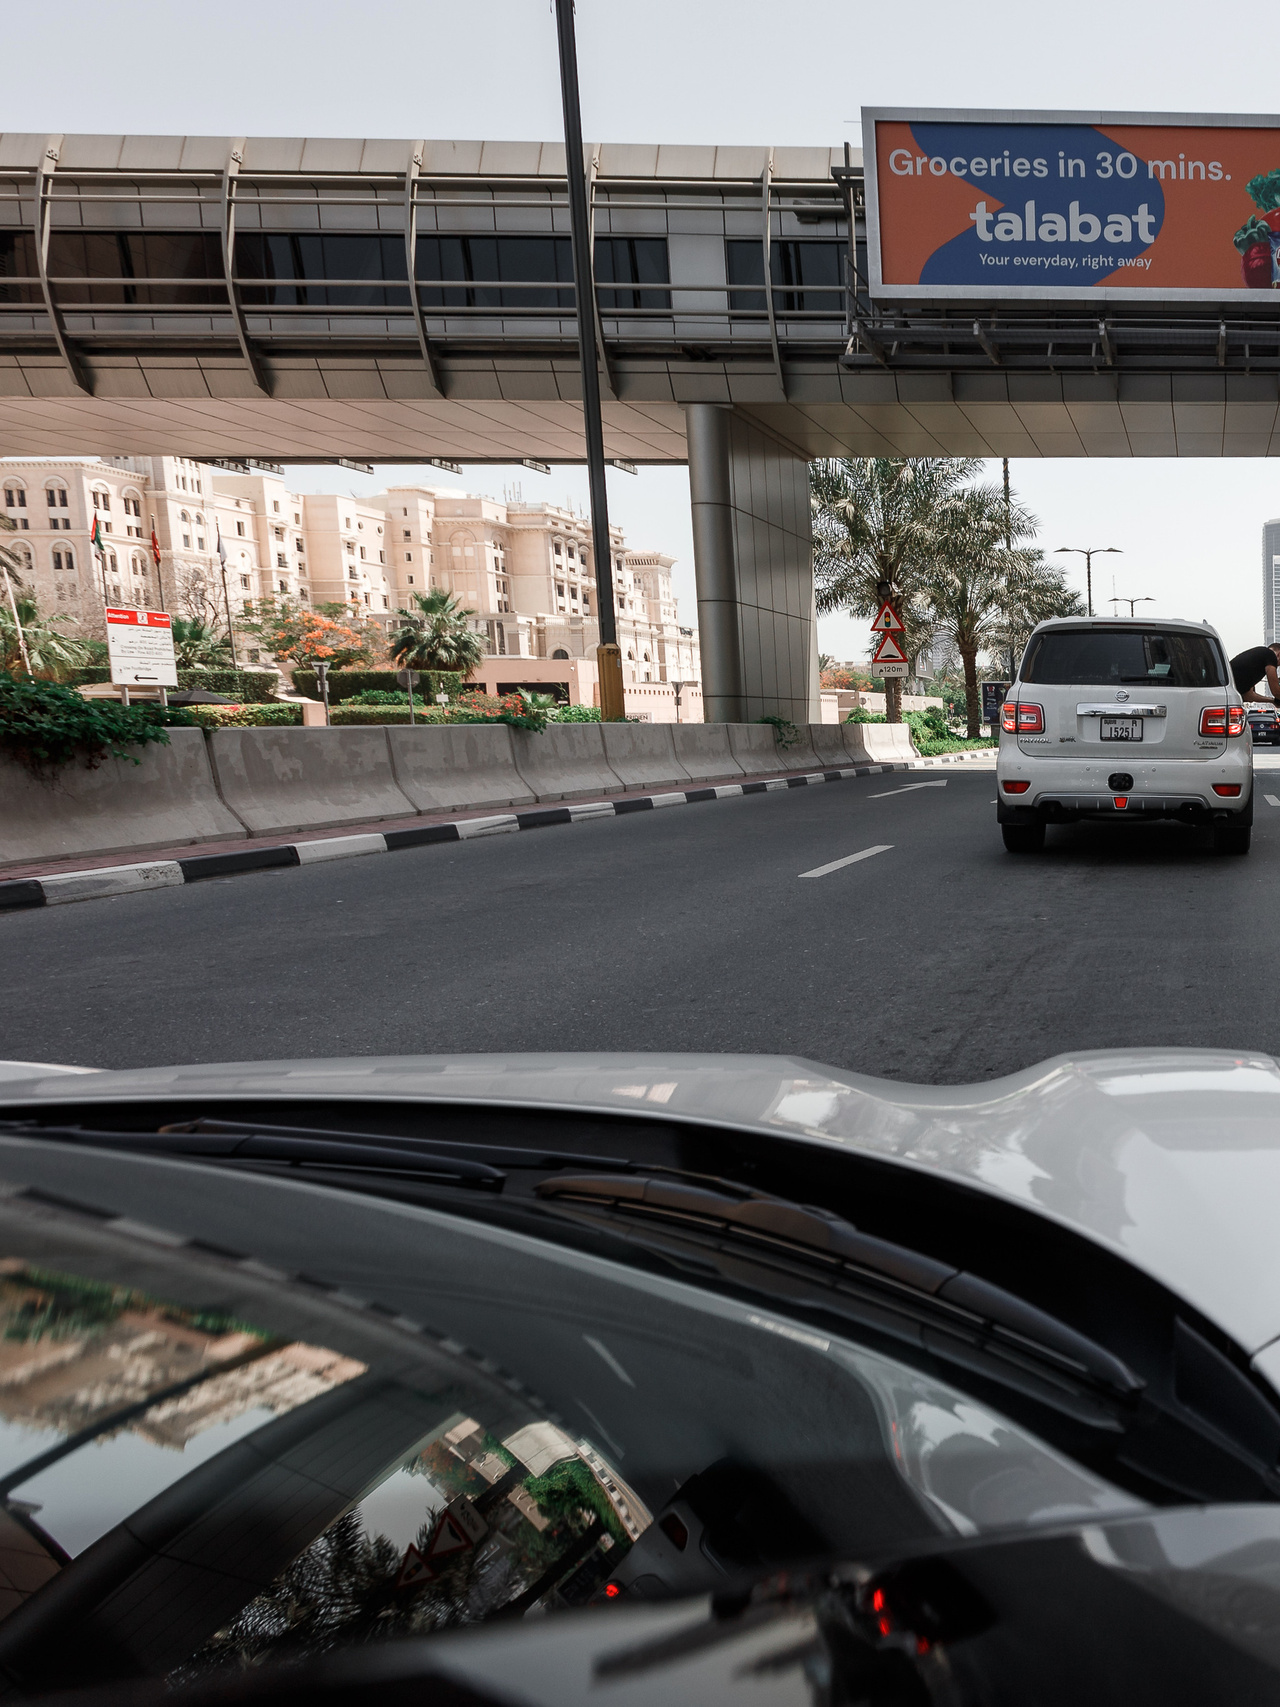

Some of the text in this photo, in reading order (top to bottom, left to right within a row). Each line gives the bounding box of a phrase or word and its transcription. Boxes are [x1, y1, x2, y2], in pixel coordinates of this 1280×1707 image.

[888, 148, 1232, 181] Groceries in 30 mins.
[969, 200, 1156, 244] talabat
[979, 253, 1152, 270] Your everyday, right away
[1110, 726, 1134, 738] 15251
